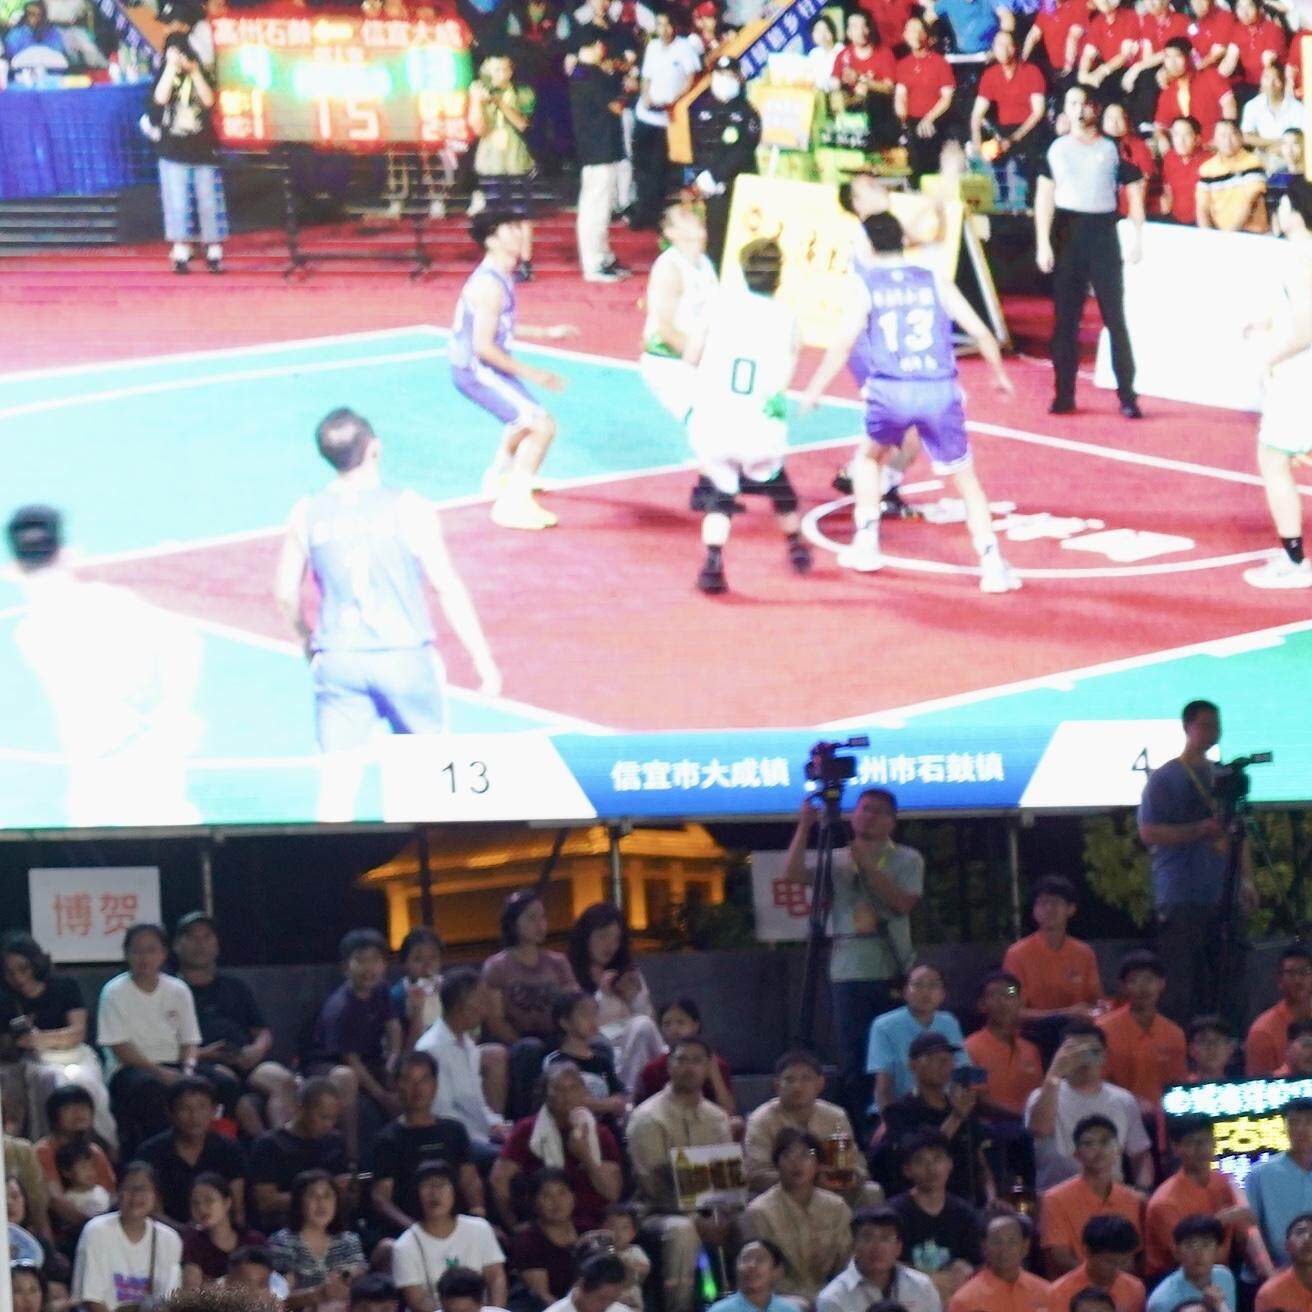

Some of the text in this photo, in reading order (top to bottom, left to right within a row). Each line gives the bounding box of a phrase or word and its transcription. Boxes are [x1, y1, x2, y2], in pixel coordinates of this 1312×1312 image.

[878, 309, 934, 353] 13
[442, 760, 492, 796] 13
[611, 756, 790, 791] 信宜市大成镇
[848, 752, 1005, 788] 州市石鼓镇
[52, 891, 140, 935] 博贺
